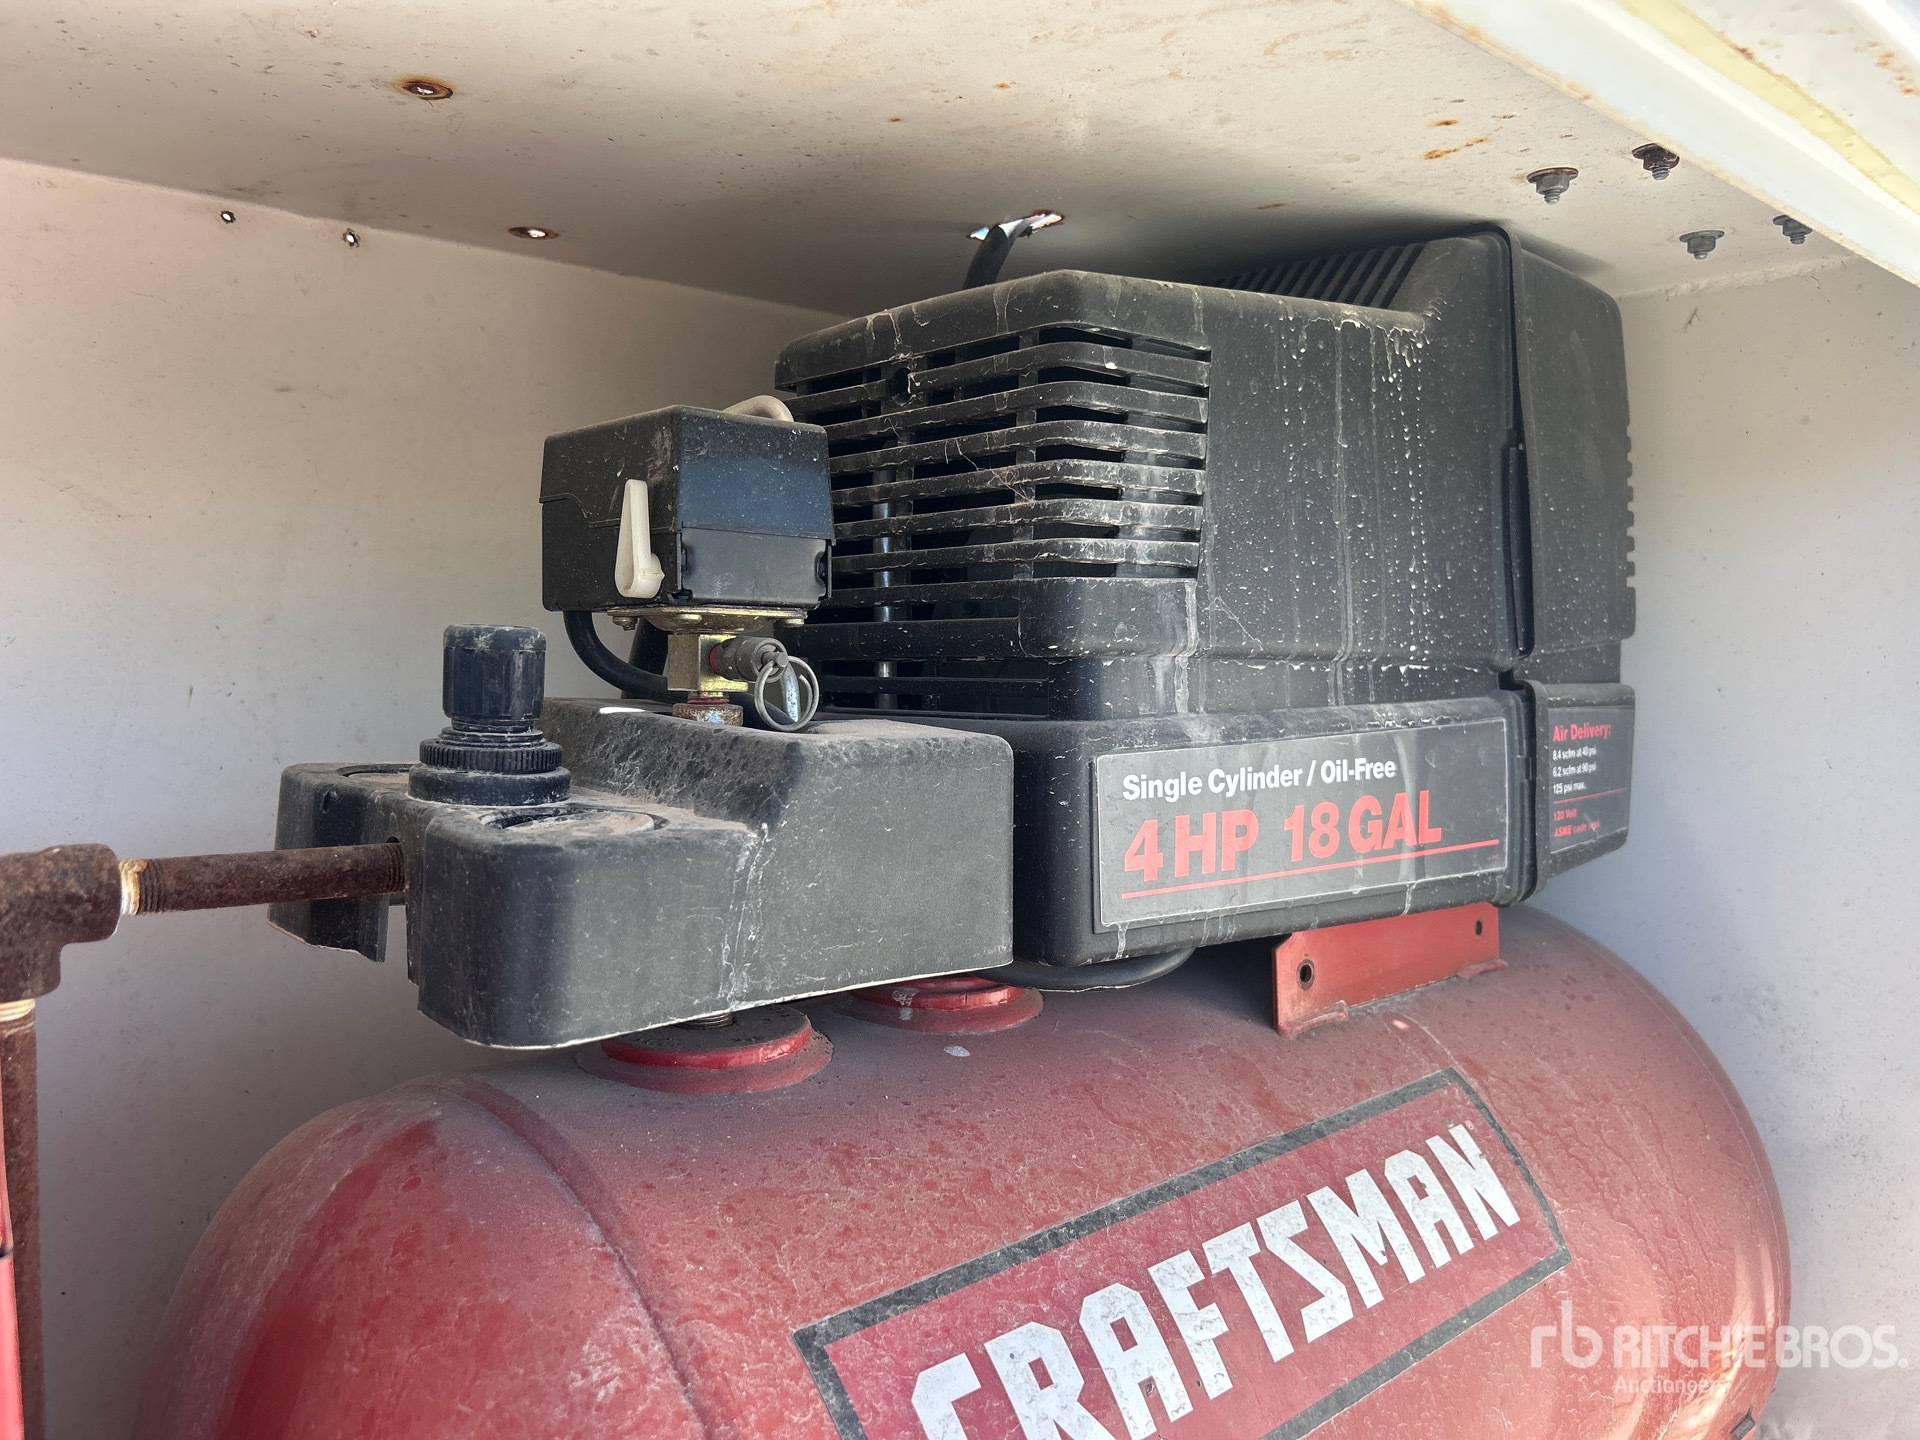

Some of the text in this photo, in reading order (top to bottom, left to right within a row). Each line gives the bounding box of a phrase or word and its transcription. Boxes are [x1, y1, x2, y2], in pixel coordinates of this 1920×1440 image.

[1553, 725, 1568, 742] Air
[1122, 771, 1203, 803] Single
[1208, 764, 1303, 798] Cylinder
[1320, 757, 1397, 784] Oil-Free
[1124, 789, 1443, 882] 4 HP 18 GAL
